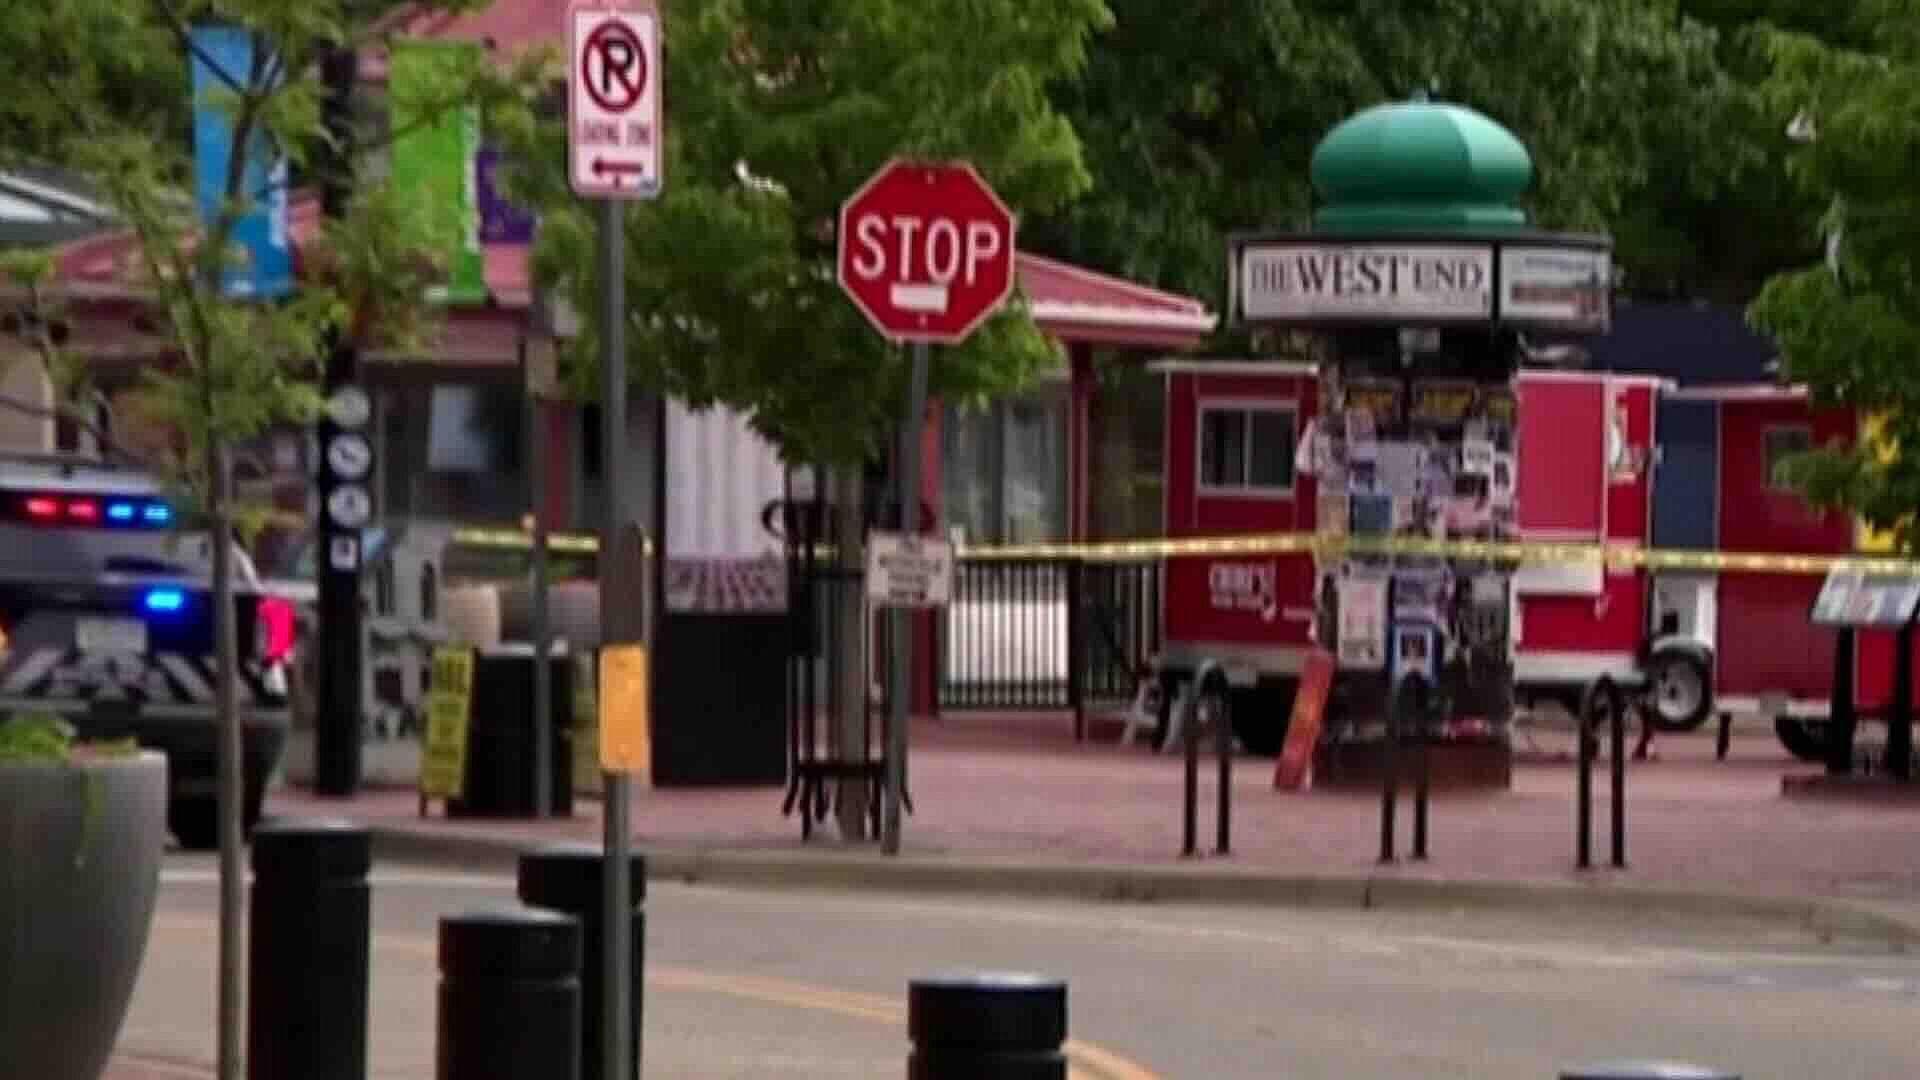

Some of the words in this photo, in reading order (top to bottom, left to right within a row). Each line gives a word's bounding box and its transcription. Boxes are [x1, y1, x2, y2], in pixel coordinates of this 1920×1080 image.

[852, 214, 1000, 286] STOP
[1297, 254, 1411, 295] WEST
[1413, 258, 1484, 289] END
